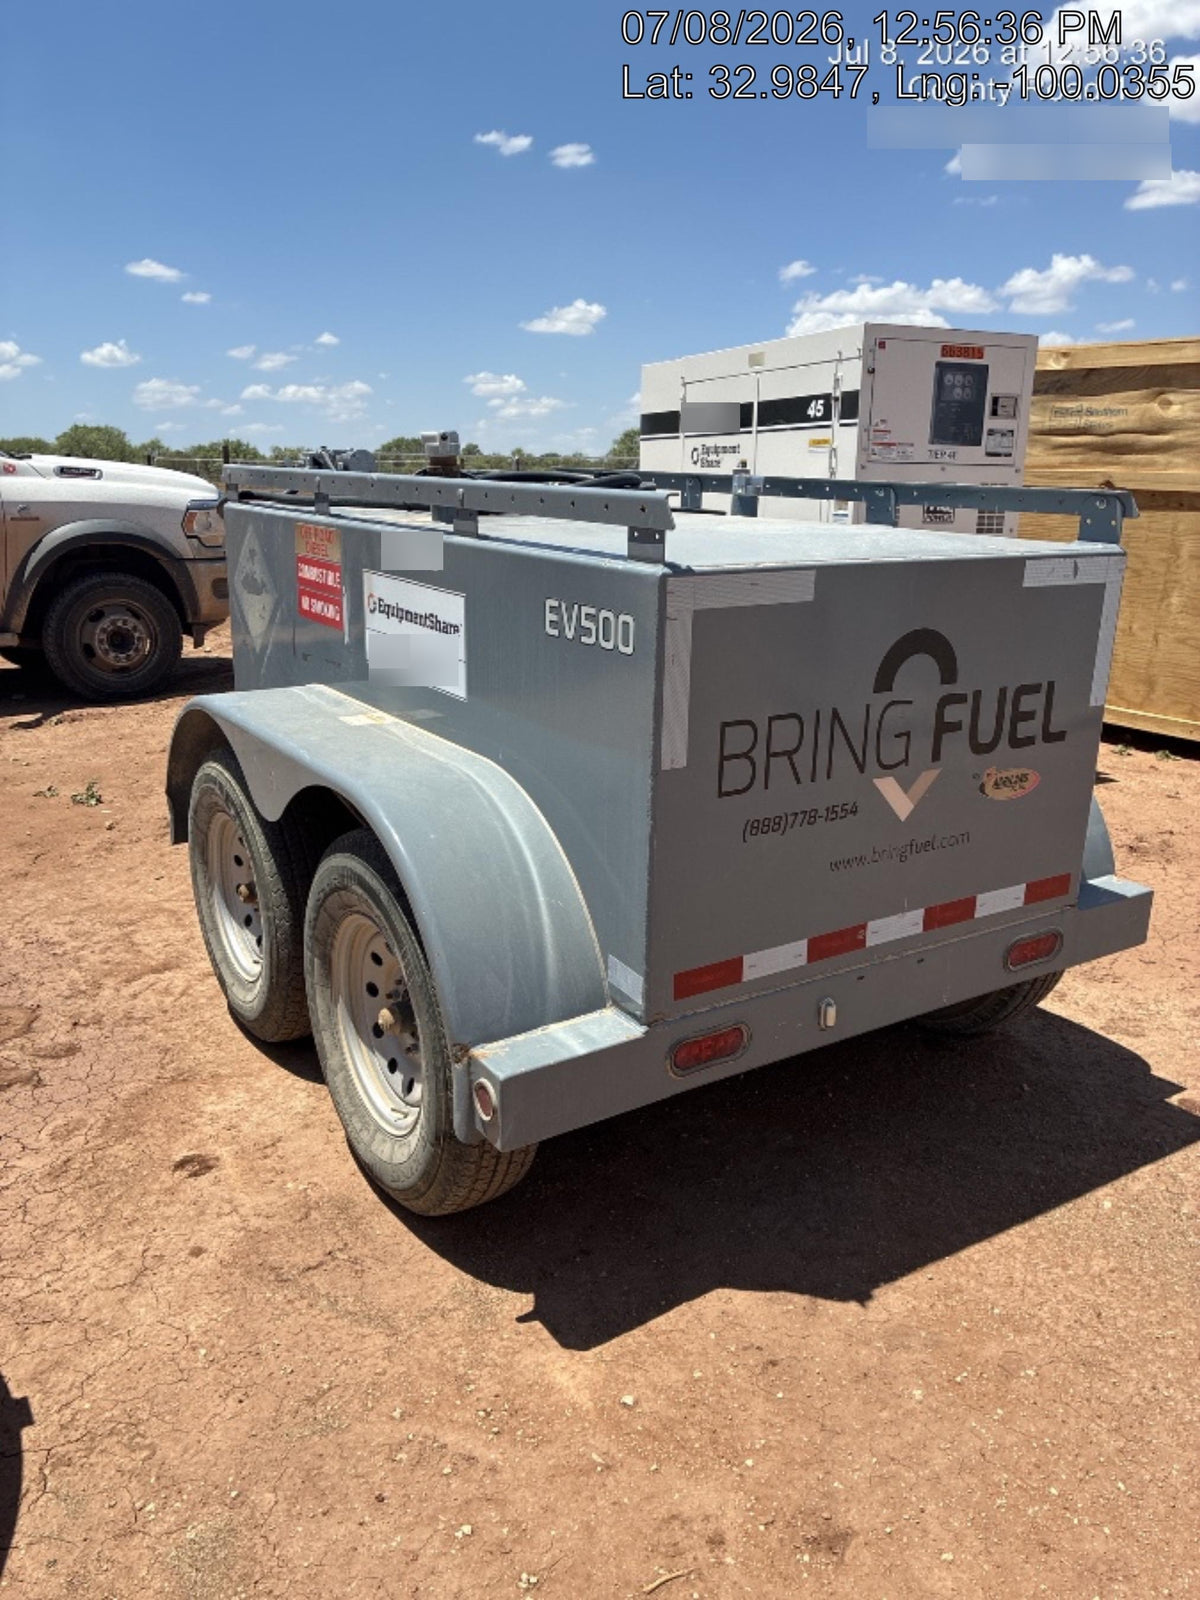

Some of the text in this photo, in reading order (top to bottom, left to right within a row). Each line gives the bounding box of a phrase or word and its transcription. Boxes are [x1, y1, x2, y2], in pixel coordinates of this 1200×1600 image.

[806, 399, 825, 418] 45
[311, 597, 340, 622] SMOKING
[378, 597, 461, 635] EquipmentShare
[544, 597, 635, 656] EV500
[718, 680, 1067, 798] BRING FUEL
[742, 801, 860, 843] (888)778-1554
[829, 831, 971, 873] www.bringfuel.com
